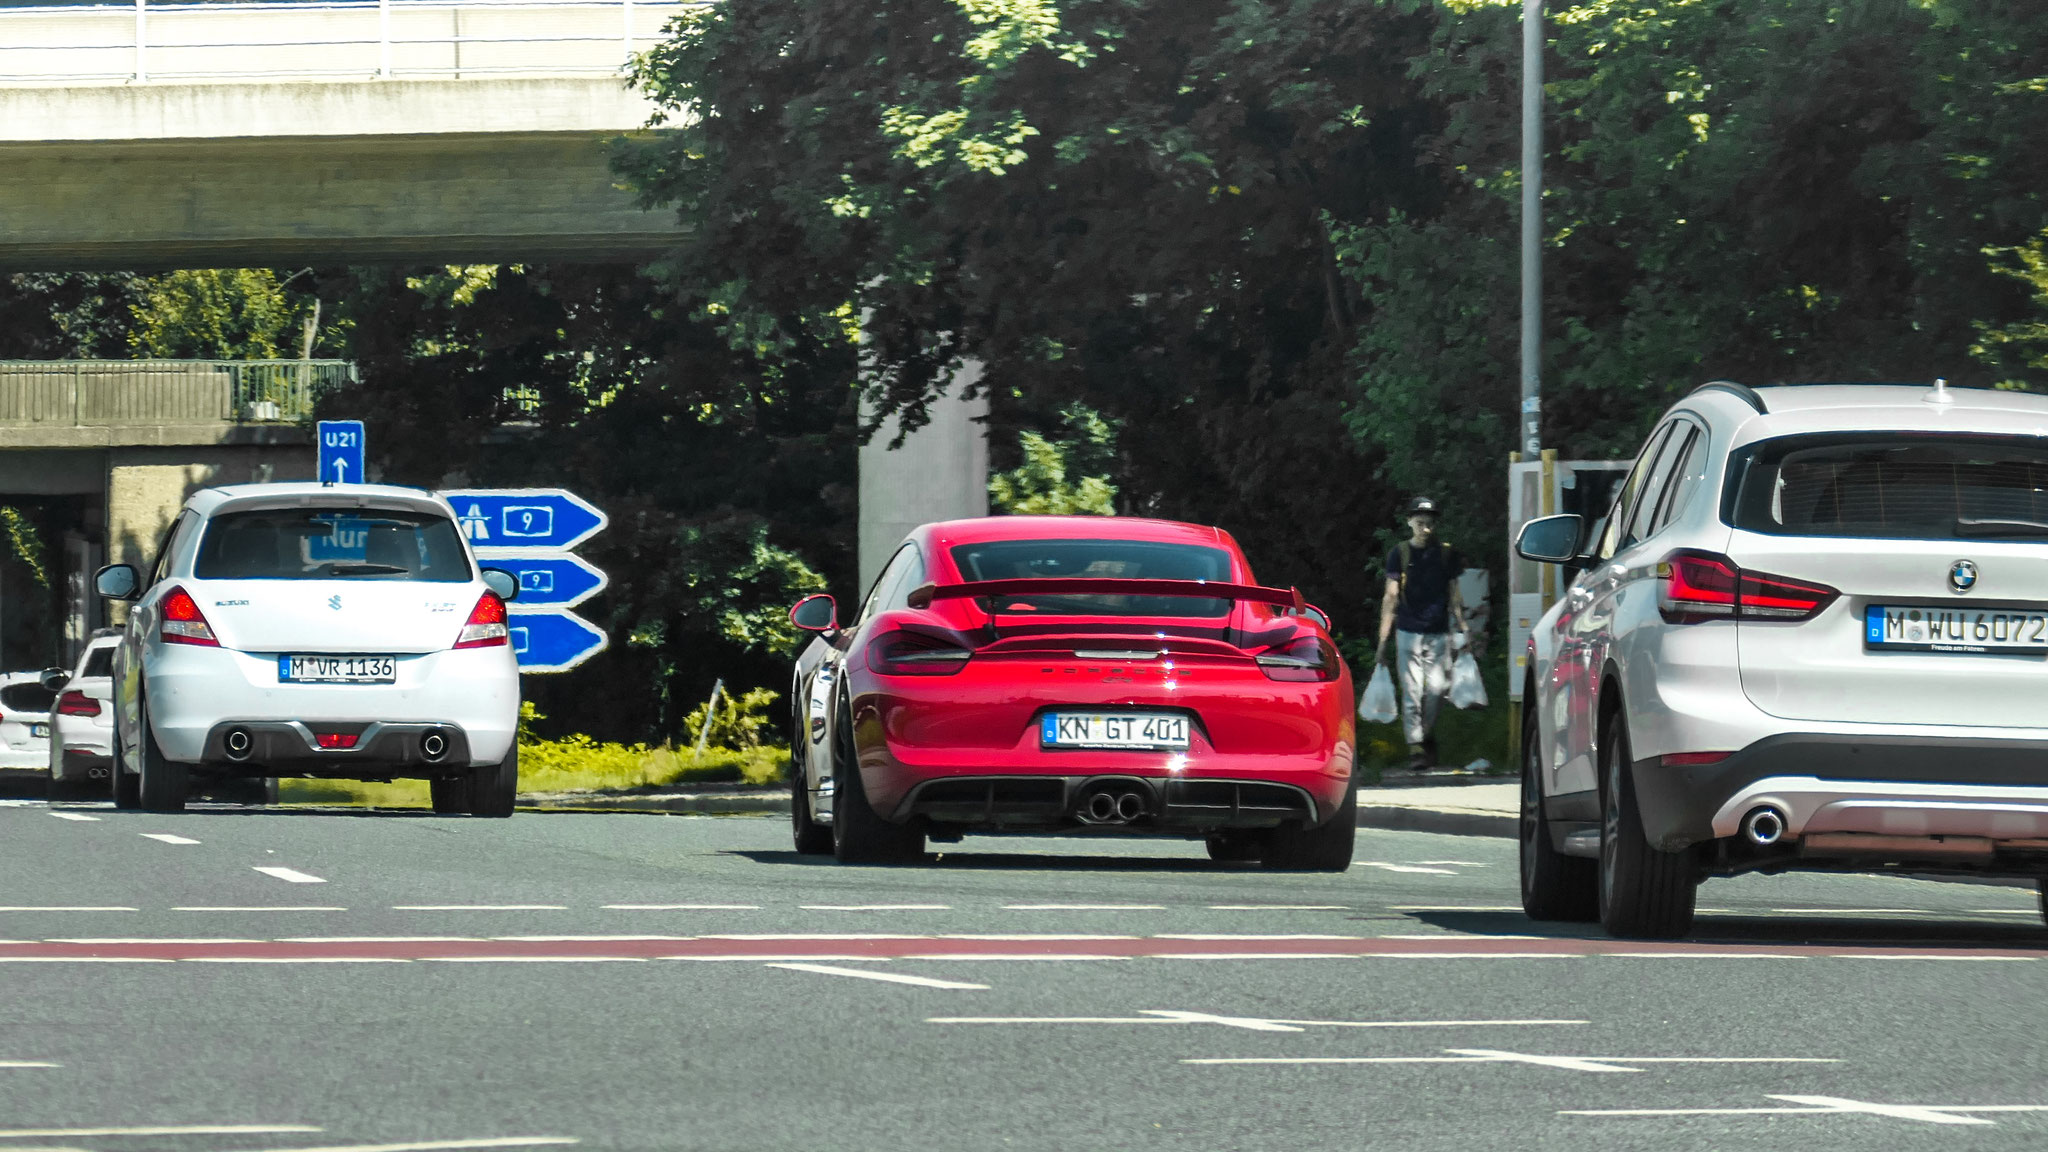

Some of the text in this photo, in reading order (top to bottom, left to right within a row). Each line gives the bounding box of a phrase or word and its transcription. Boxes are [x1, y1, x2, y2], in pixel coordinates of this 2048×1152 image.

[325, 431, 357, 448] U21
[522, 511, 533, 531] 9
[531, 573, 541, 587] 9
[1886, 611, 2046, 643] M WU 6072
[291, 658, 393, 676] M VR 1136
[1058, 717, 1186, 741] KN GT 401
